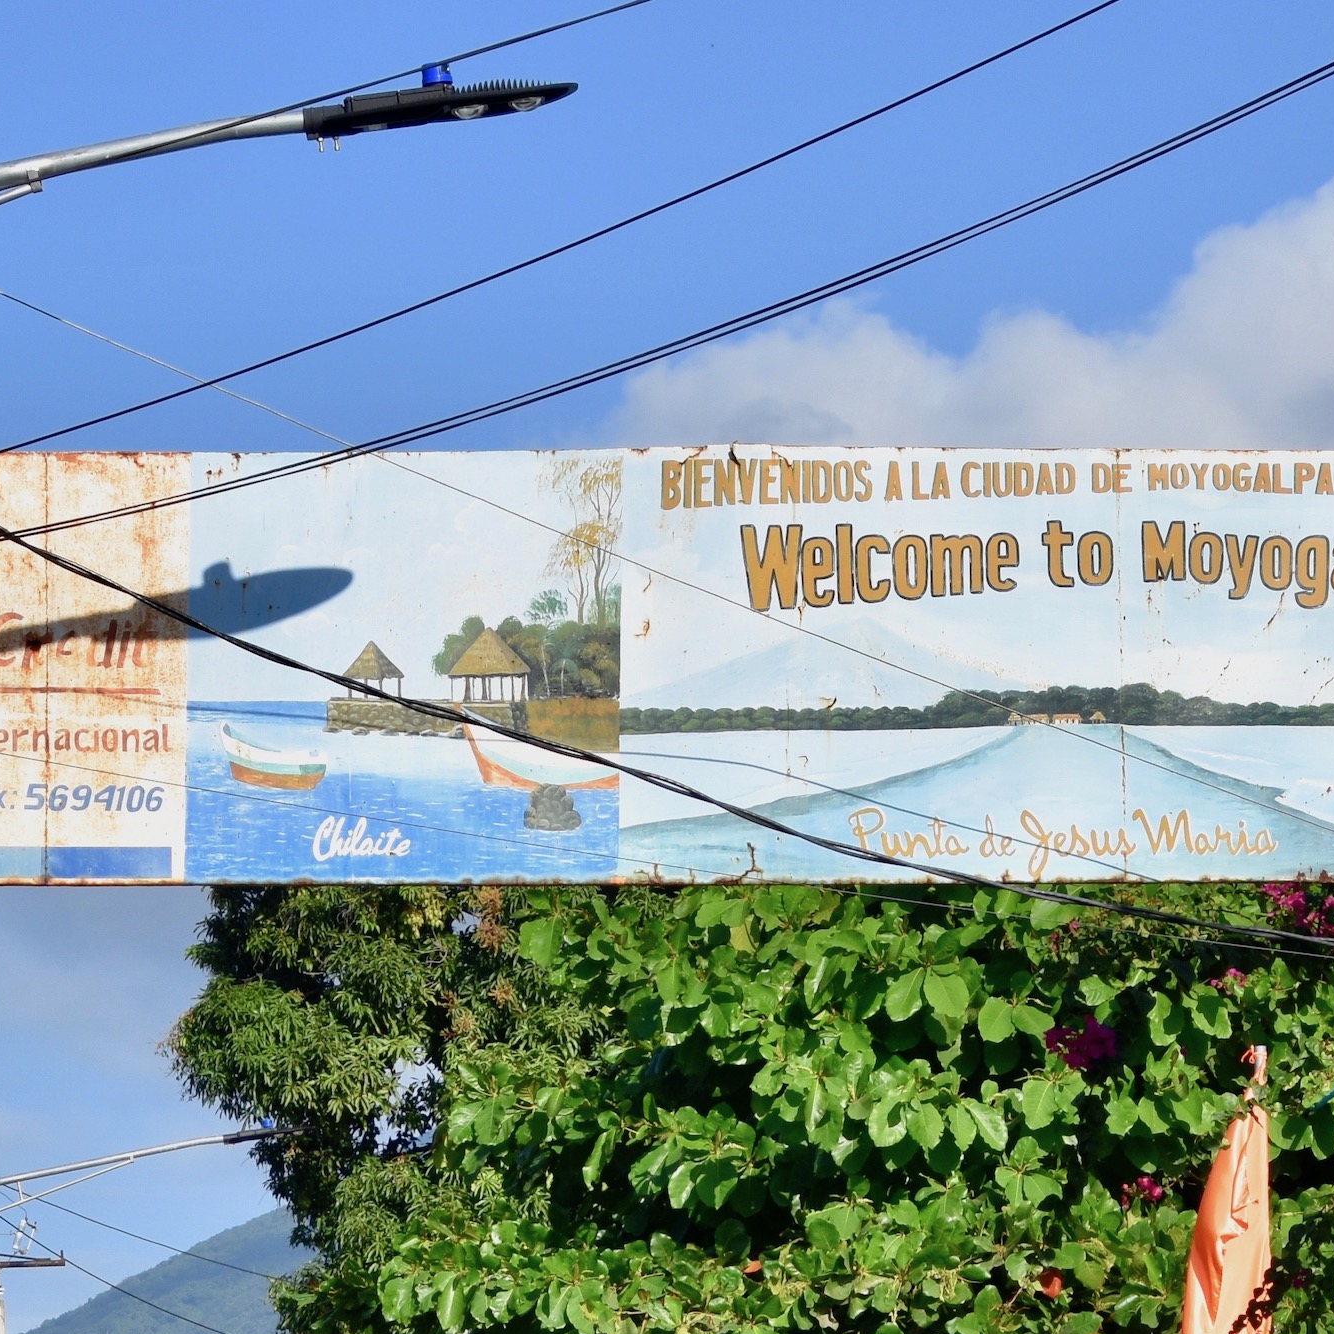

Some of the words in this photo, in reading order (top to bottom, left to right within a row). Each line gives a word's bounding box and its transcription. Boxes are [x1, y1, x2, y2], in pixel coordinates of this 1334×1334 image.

[660, 458, 873, 510] BIENVENIDOS
[885, 460, 904, 500] A
[911, 460, 952, 500] LA
[961, 461, 1077, 499] CIUDAD
[1092, 462, 1133, 494] DE
[740, 522, 1021, 613] Welcome
[1042, 519, 1115, 589] to
[23, 782, 166, 815] 5694106
[849, 806, 970, 860] Punta
[978, 813, 1016, 858] de
[1019, 809, 1136, 882] Jesus
[1133, 808, 1278, 857] Maria
